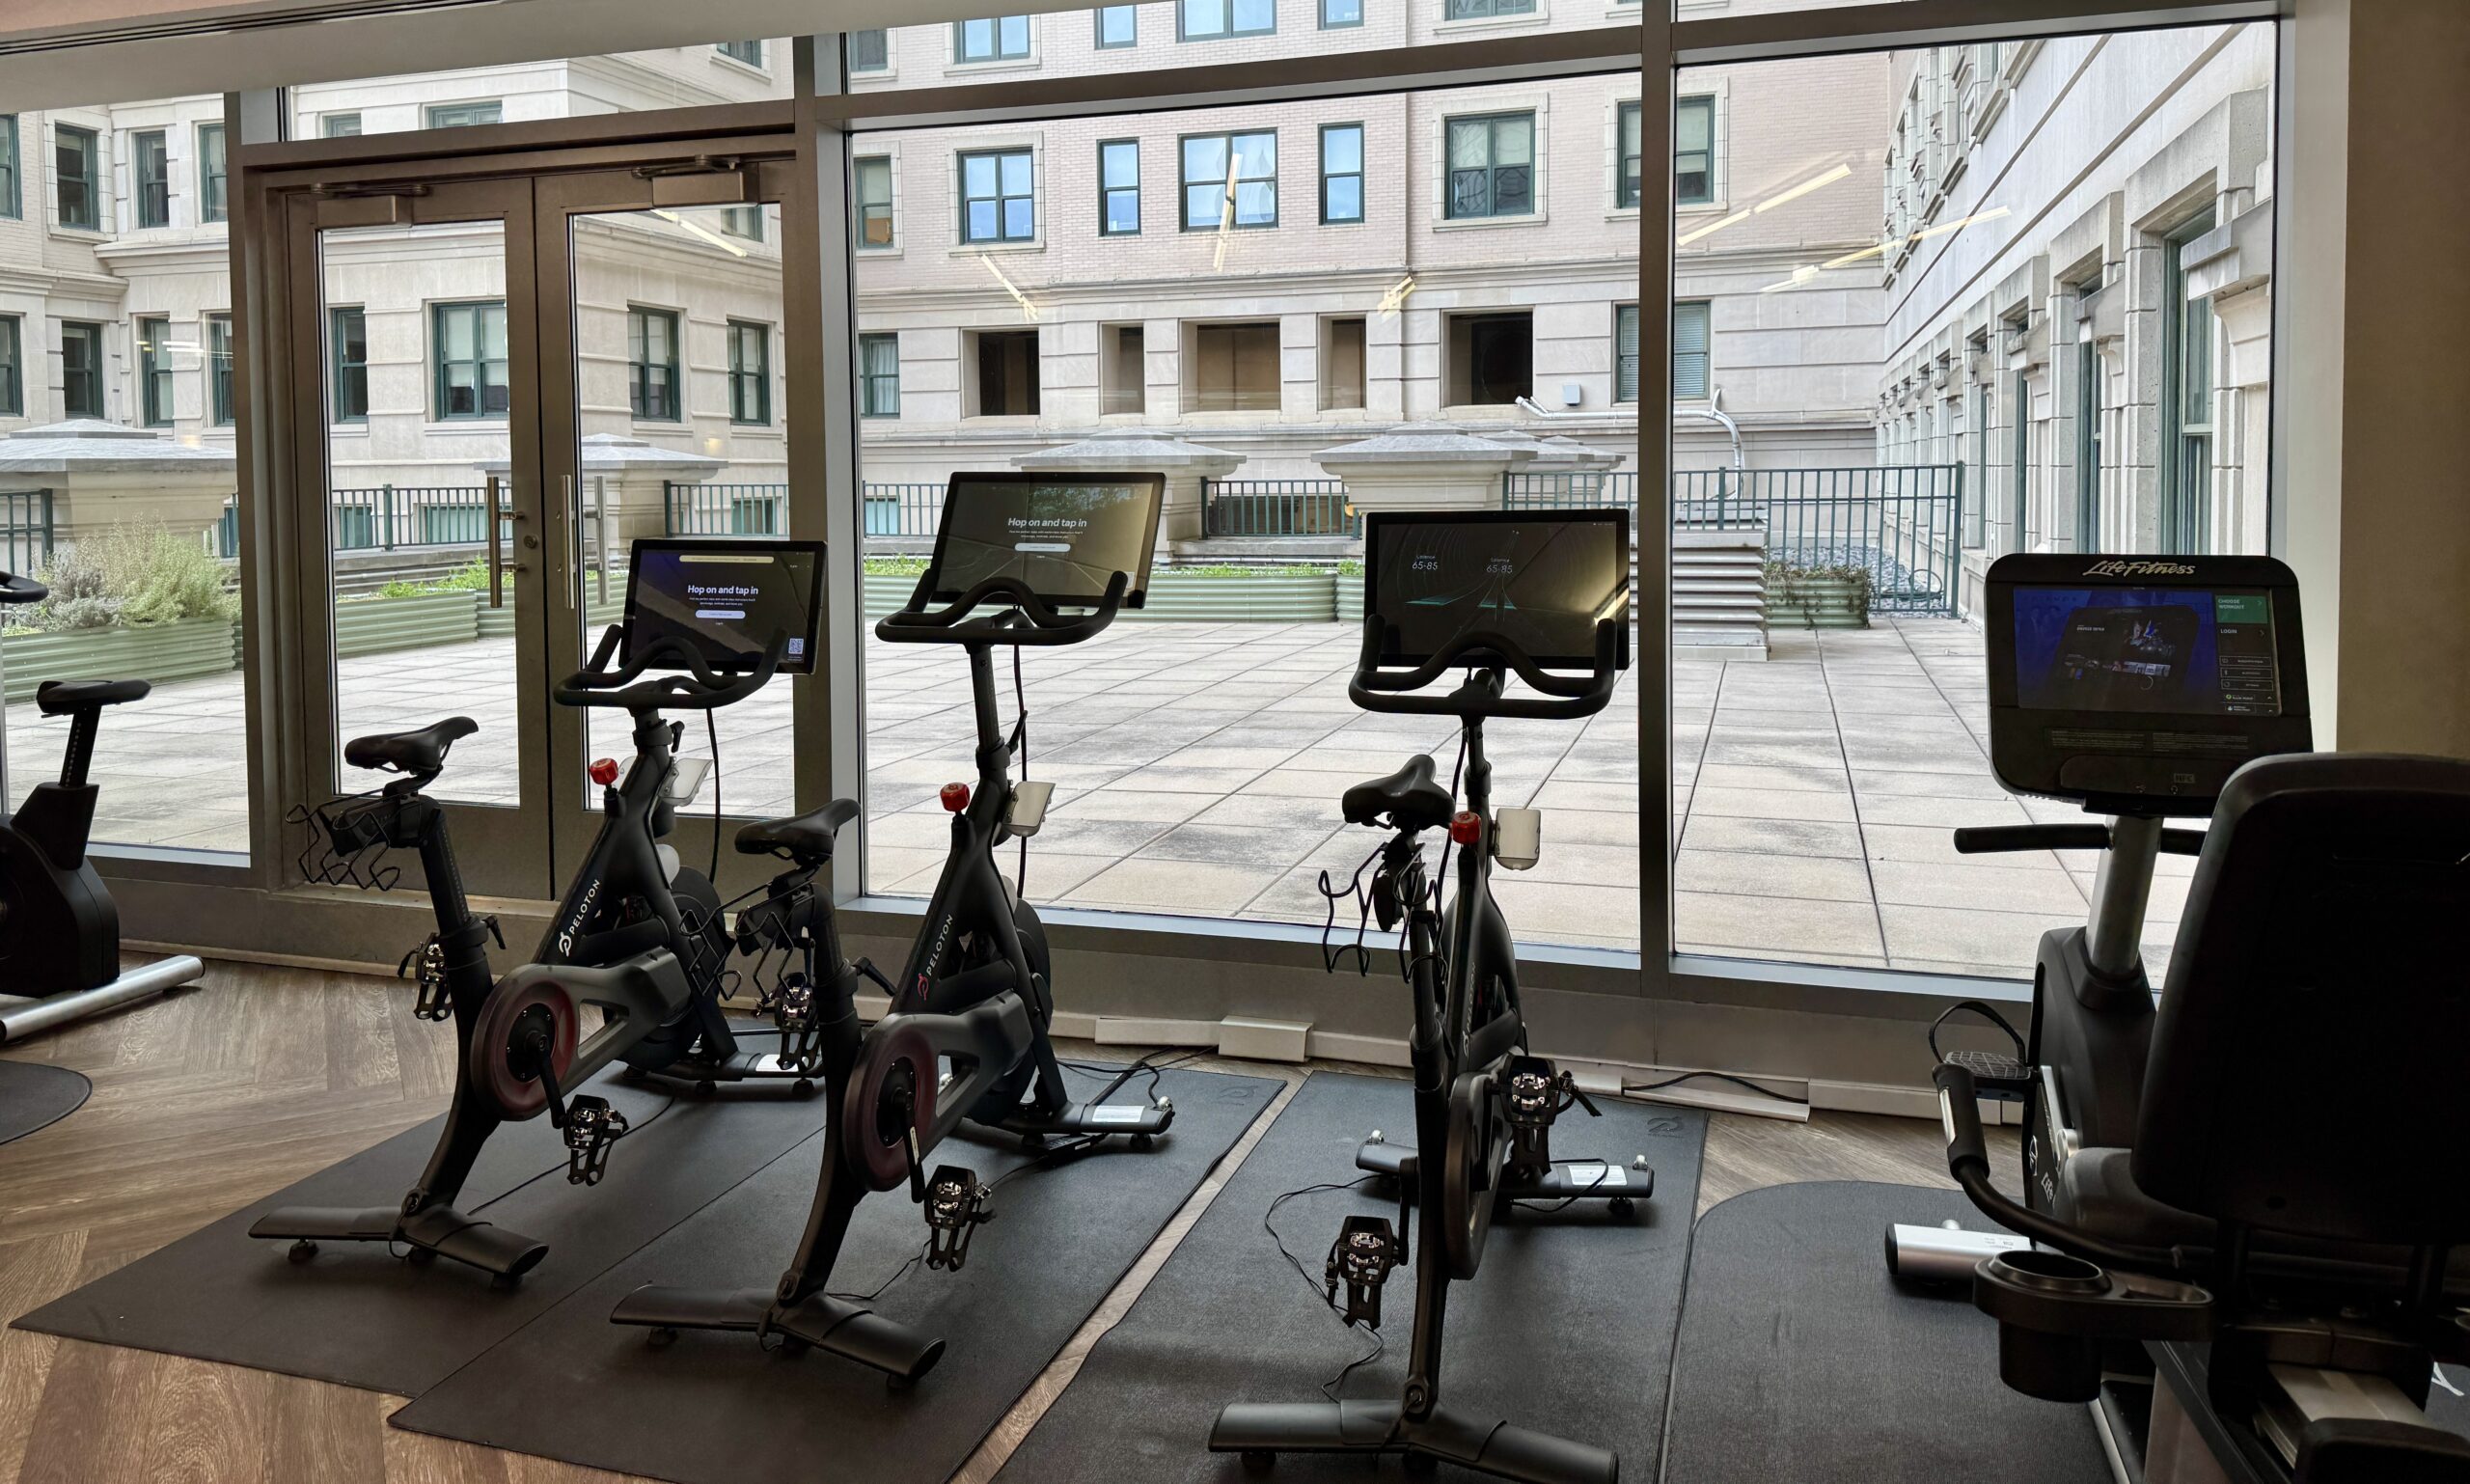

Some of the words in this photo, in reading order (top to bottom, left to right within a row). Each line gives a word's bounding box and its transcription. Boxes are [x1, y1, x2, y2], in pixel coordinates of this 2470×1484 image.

[1008, 517, 1027, 529] Hop
[1042, 518, 1060, 527] and
[1061, 518, 1077, 529] tap
[1078, 518, 1087, 527] in
[1412, 561, 1438, 570] 65-85
[687, 585, 704, 595] Hop
[718, 586, 734, 594] and
[735, 587, 750, 596] tap
[568, 879, 601, 935] PELOTON
[926, 914, 954, 976] PELOTON
